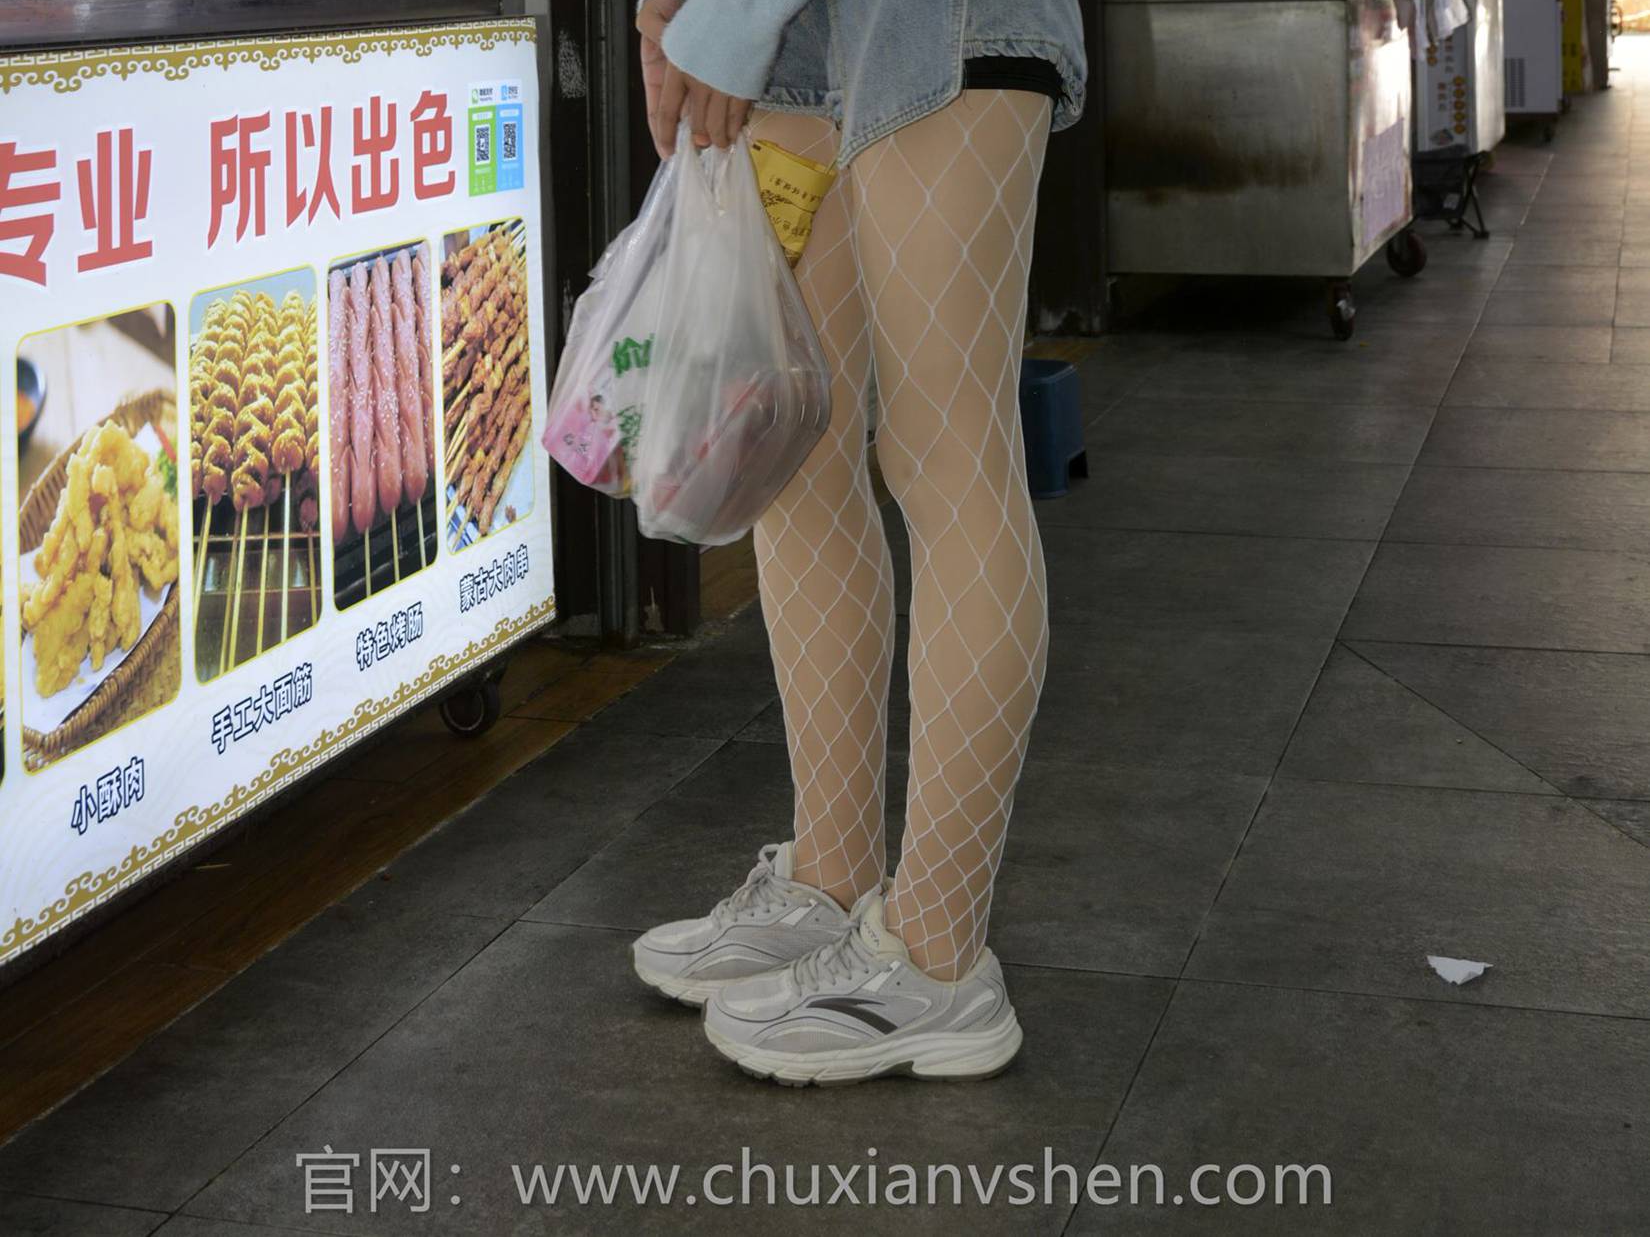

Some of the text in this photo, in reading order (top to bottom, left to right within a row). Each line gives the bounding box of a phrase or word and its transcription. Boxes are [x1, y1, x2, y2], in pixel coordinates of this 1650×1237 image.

[0, 89, 457, 287] 专业 所以出色
[458, 544, 529, 614] 蒙古大肉串
[355, 601, 424, 671] 特色烤肠
[211, 662, 313, 754] 手工大面筋
[70, 756, 145, 837] 小酥肉
